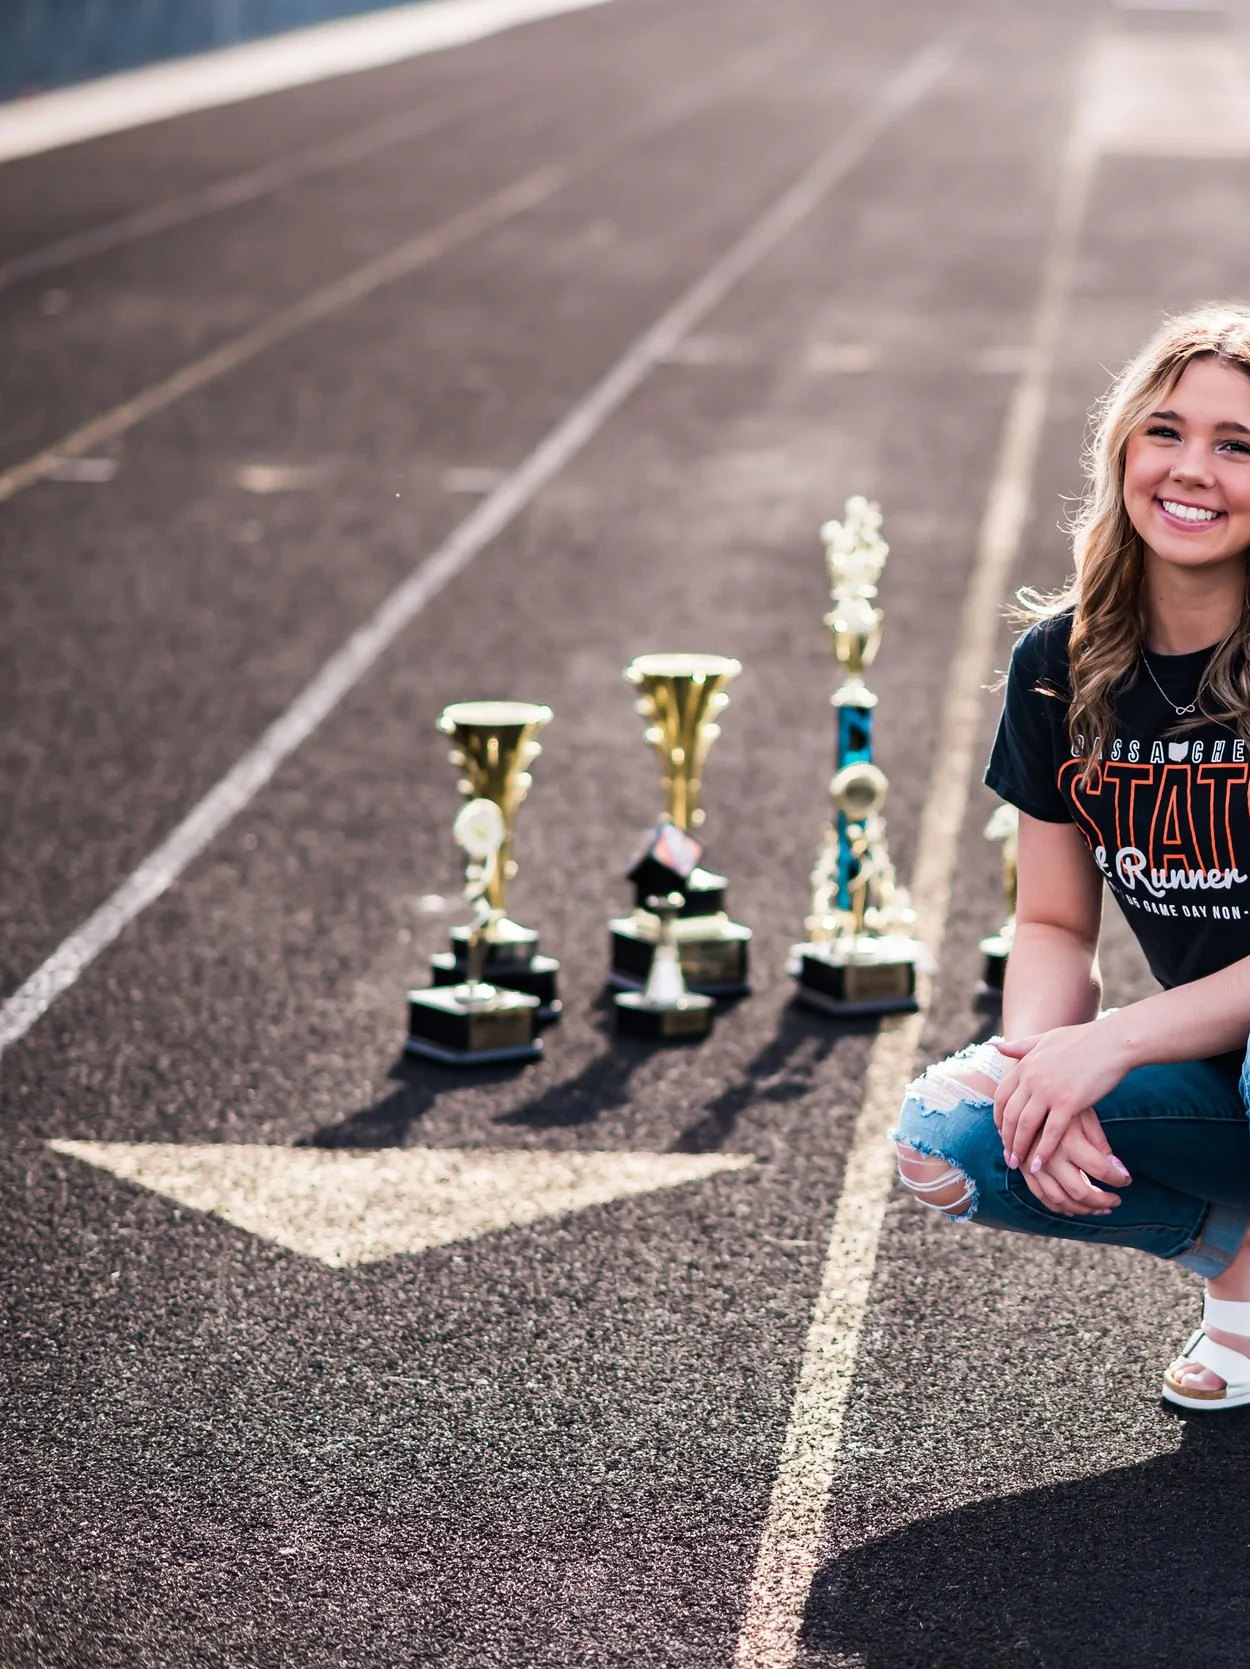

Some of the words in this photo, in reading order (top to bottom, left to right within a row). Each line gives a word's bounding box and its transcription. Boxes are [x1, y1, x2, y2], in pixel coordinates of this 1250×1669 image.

[1115, 846, 1248, 898] Runner
[1143, 899, 1179, 917] GAME
[1182, 904, 1207, 918] DAY
